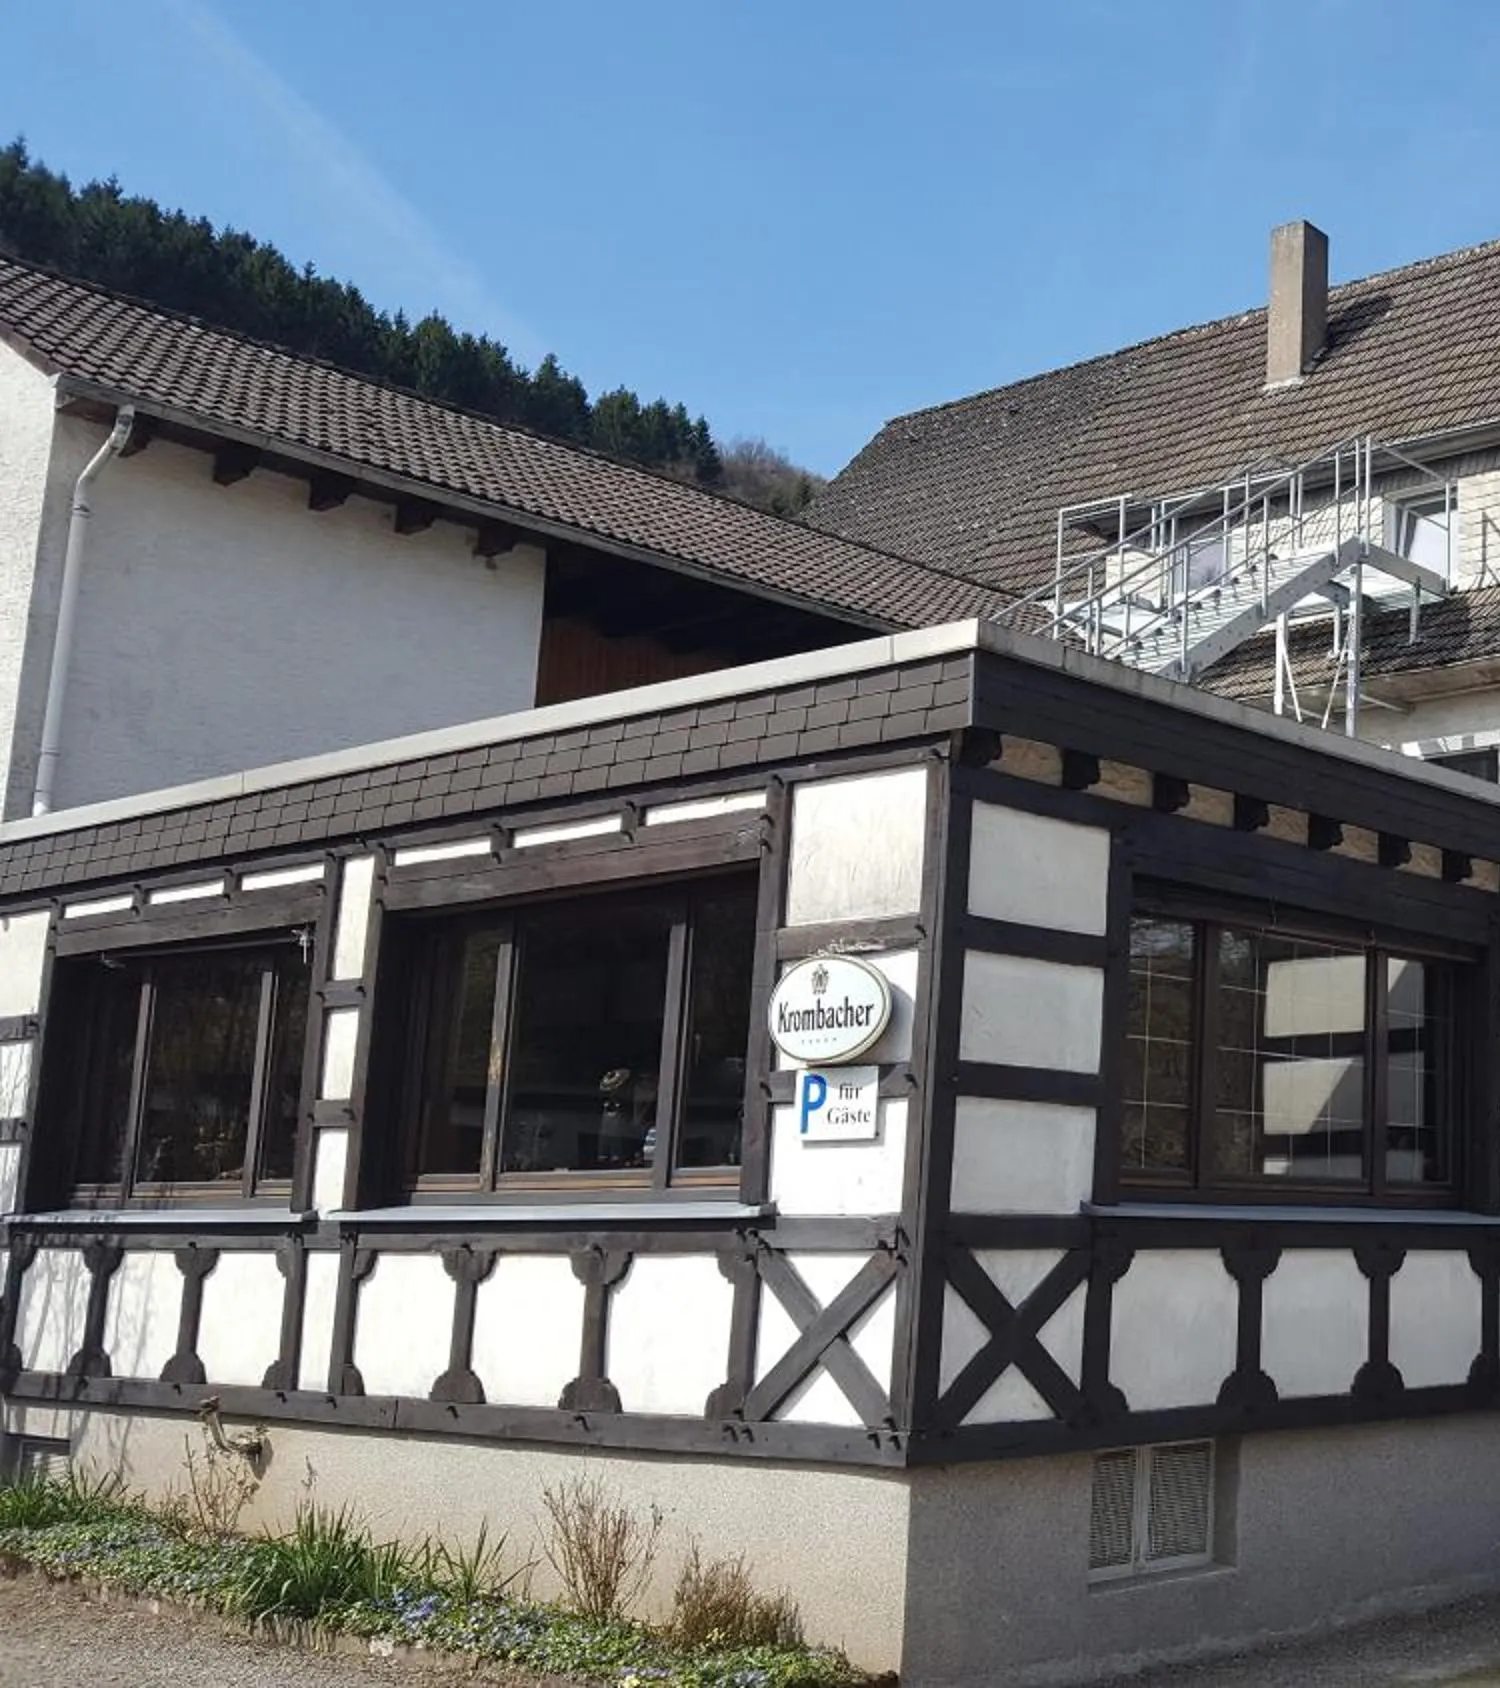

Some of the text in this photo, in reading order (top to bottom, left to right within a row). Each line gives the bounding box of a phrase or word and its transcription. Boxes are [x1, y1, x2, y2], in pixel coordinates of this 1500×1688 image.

[779, 996, 874, 1034] Krombacher
[800, 1074, 827, 1134] P
[839, 1082, 863, 1101] für
[826, 1107, 871, 1124] Gäste
